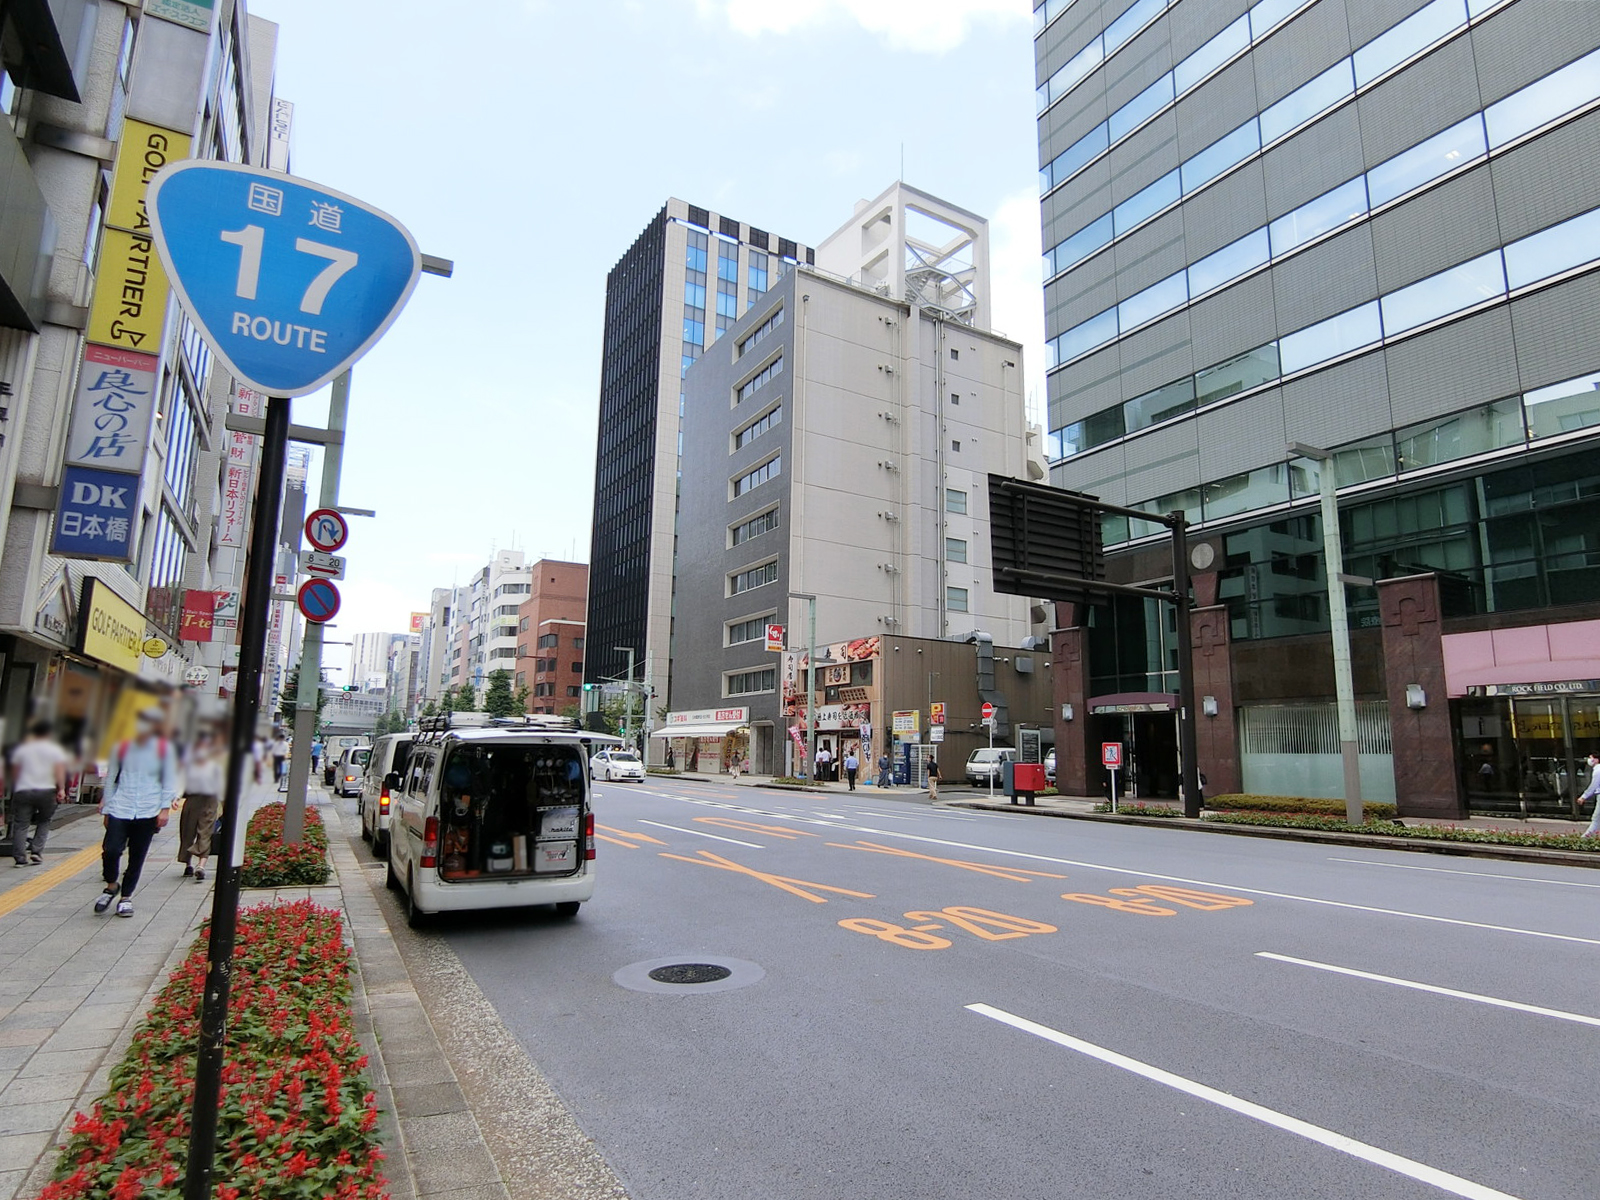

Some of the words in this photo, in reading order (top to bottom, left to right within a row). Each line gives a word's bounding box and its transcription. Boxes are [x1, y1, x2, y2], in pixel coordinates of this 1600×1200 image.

[248, 182, 344, 234] 国道
[221, 224, 359, 316] 17
[232, 311, 328, 353] ROUTE
[78, 369, 149, 460] 良心の店
[71, 481, 128, 509] DK
[221, 467, 242, 542] 新日本リフォーム
[60, 511, 129, 543] 日本橋
[92, 607, 111, 635] GOLF
[184, 614, 212, 628] T-te
[1511, 685, 1533, 693] ROCK
[1533, 684, 1554, 692] FIELD
[837, 906, 1058, 951] 8-20
